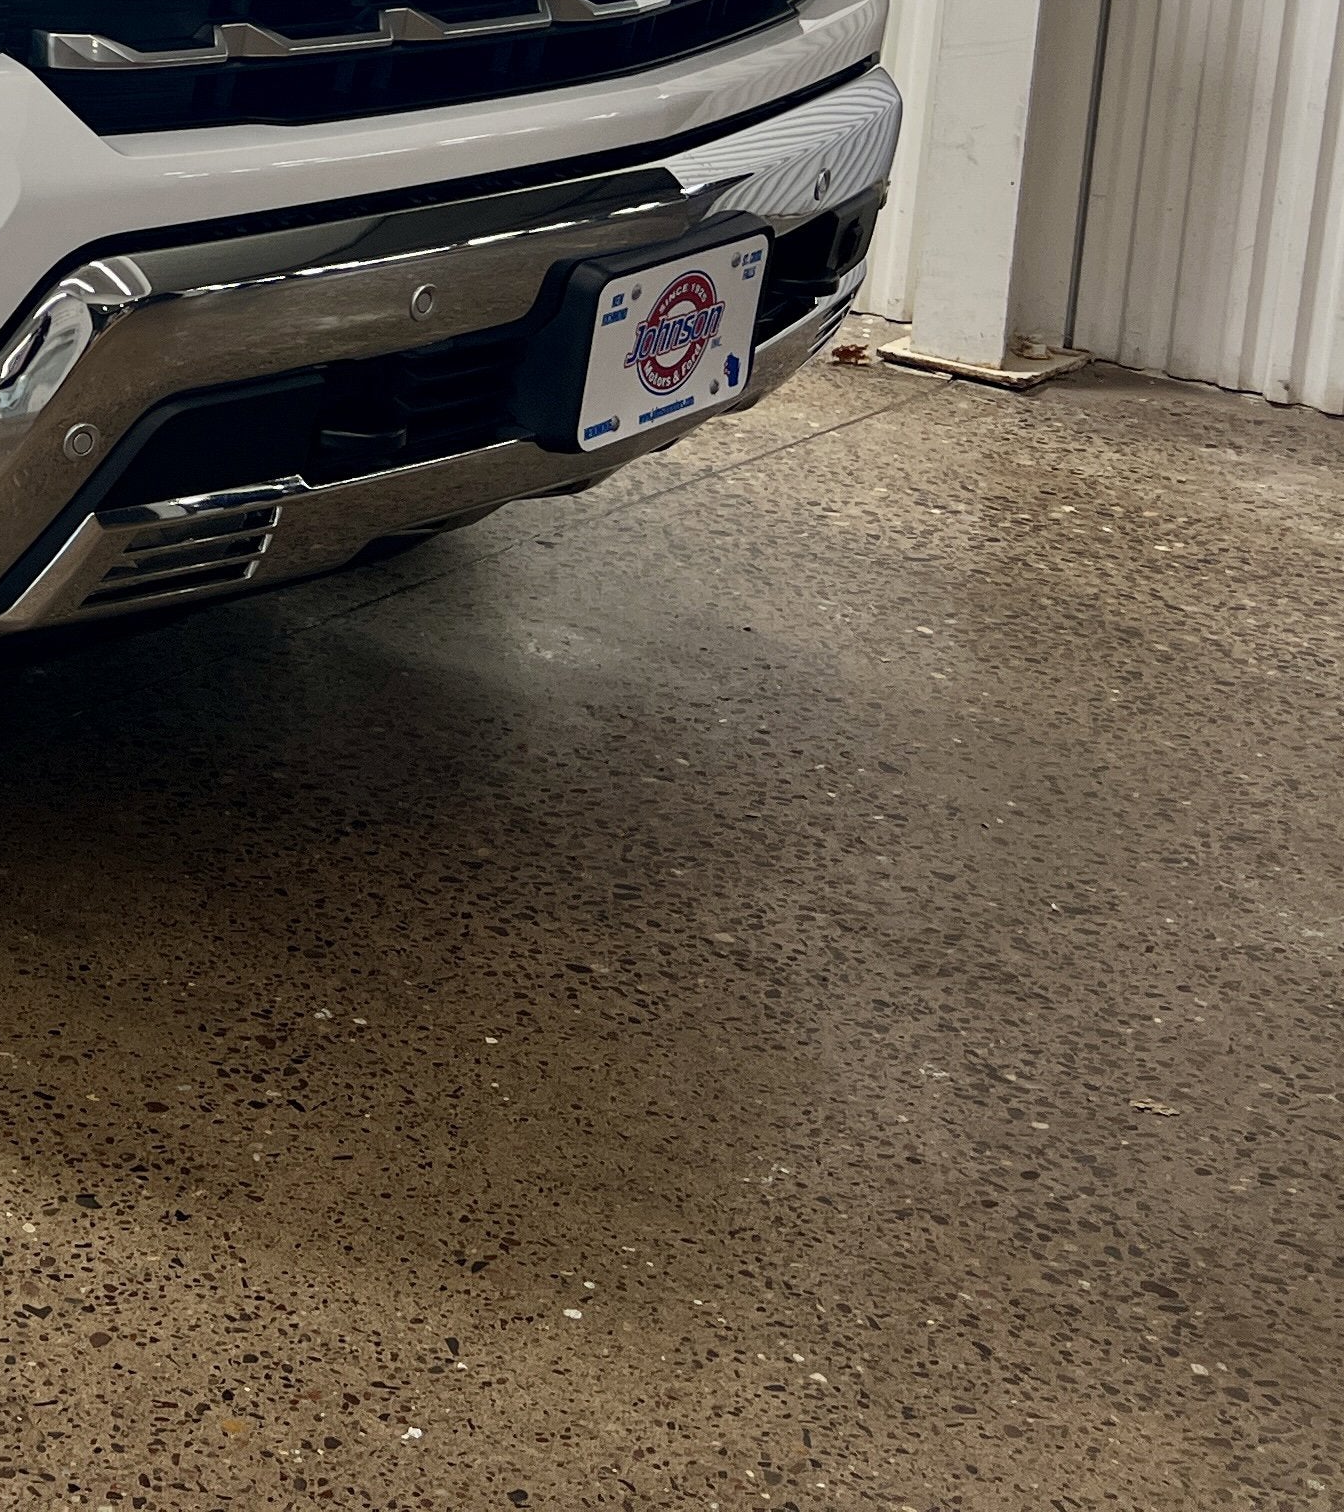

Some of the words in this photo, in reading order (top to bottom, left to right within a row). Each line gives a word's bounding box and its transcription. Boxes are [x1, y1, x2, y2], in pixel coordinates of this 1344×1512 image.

[624, 301, 725, 369] Johnson
[643, 360, 671, 387] Motors
[672, 370, 680, 384] &
[681, 343, 702, 376] Ford
